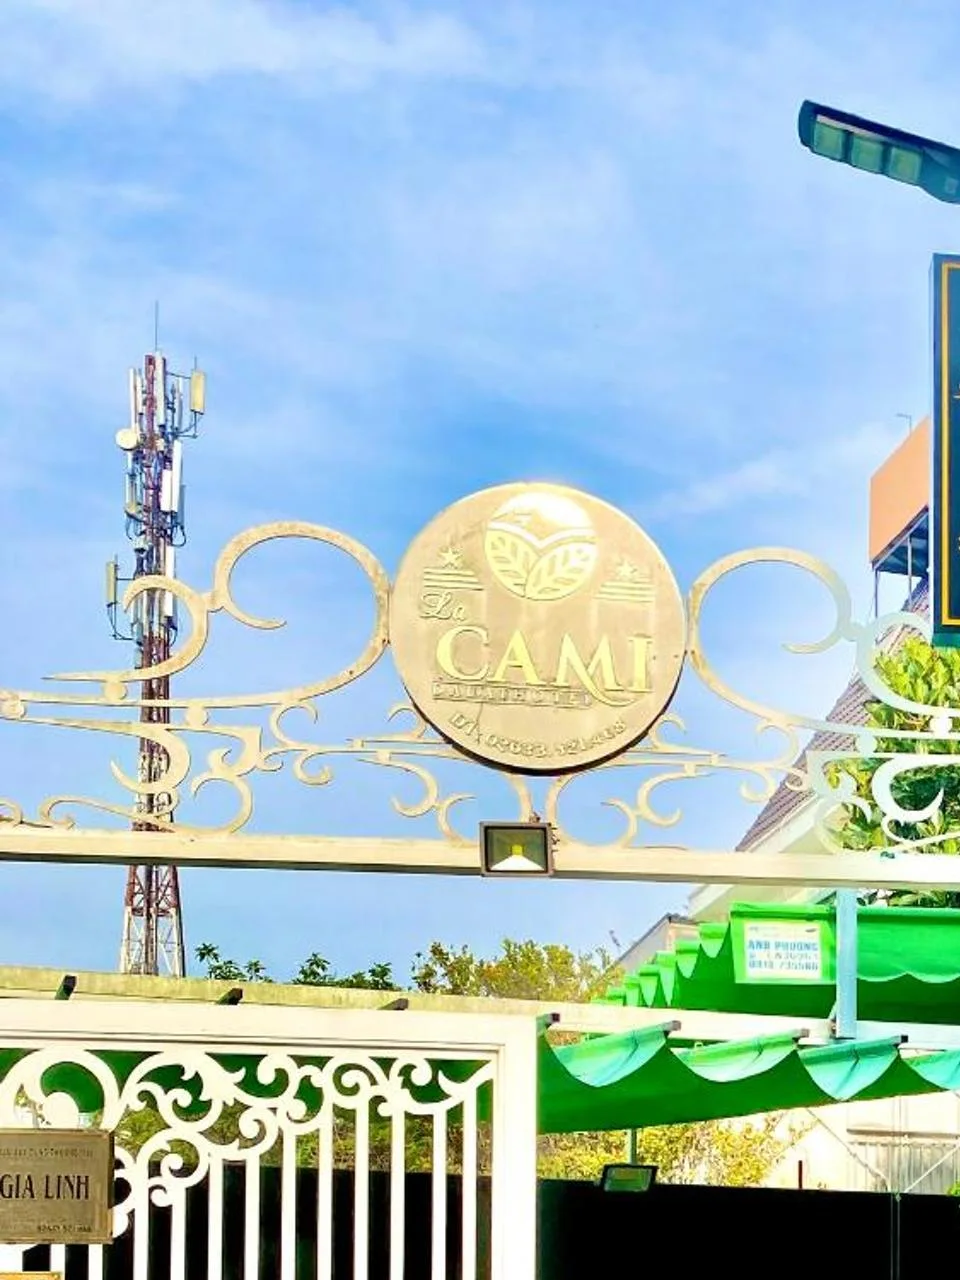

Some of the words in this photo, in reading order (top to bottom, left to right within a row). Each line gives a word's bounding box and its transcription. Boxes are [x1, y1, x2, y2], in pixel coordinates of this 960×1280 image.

[419, 591, 467, 621] La
[435, 625, 654, 707] CAMI
[0, 1173, 35, 1199] GIA
[44, 1174, 90, 1200] LINH
